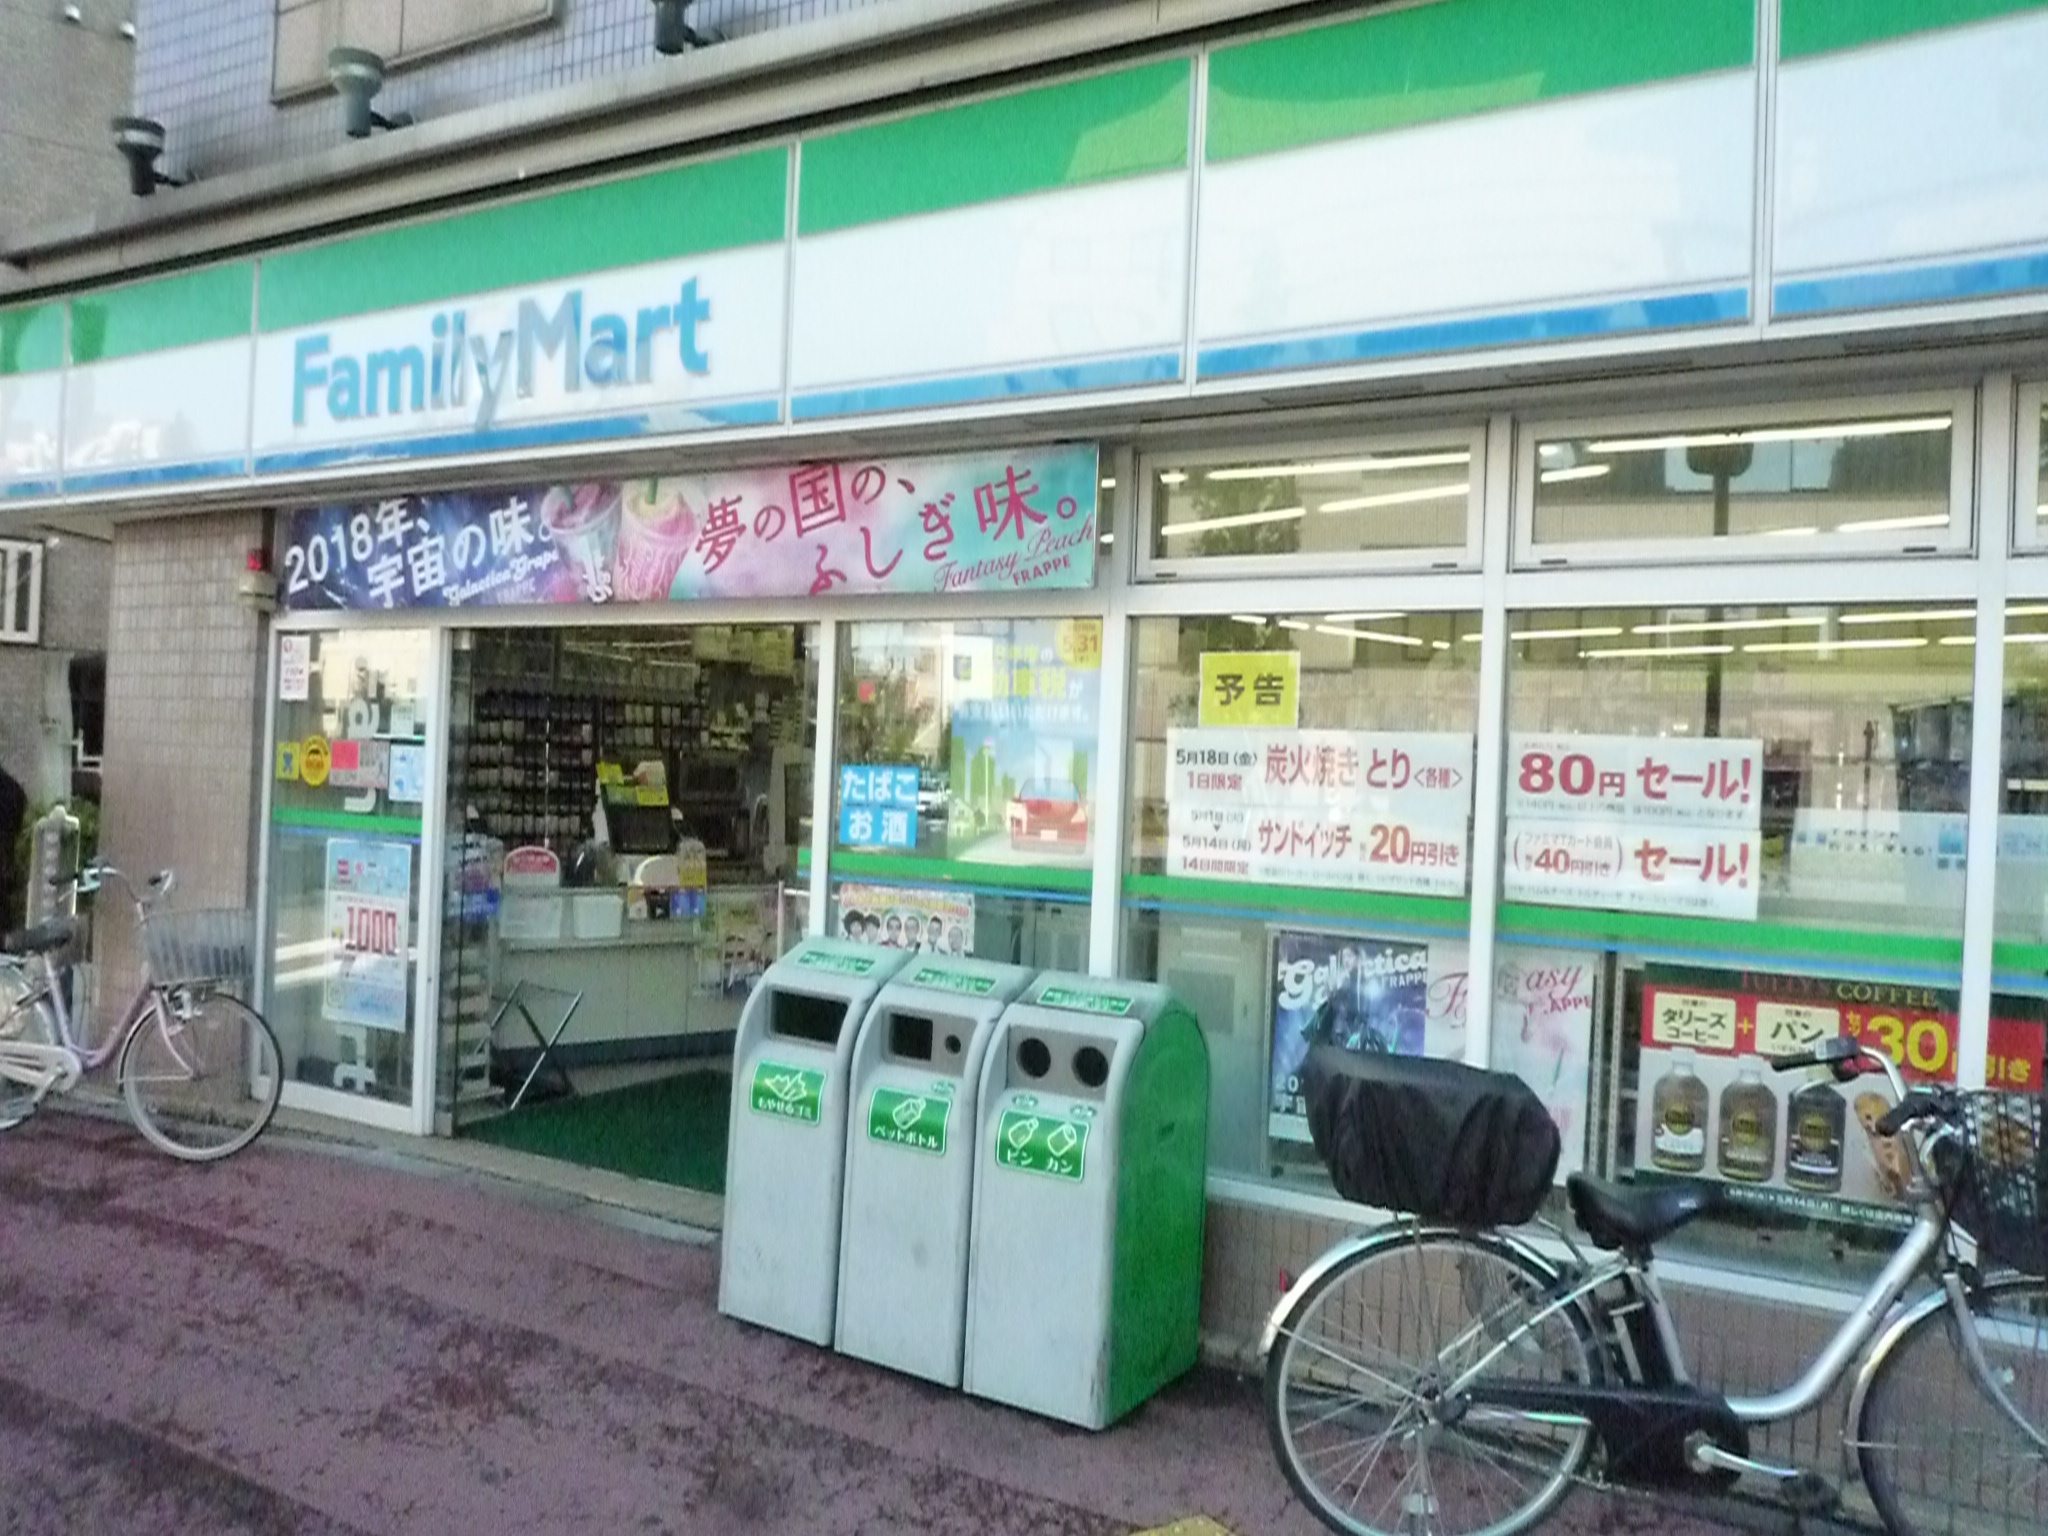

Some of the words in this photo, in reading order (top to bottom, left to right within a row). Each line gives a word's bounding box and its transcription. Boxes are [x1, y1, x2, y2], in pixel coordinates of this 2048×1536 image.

[292, 277, 712, 433] FamilyMart
[934, 551, 1019, 593] Fantasy
[1025, 512, 1093, 561] Peach
[1013, 554, 1071, 586] FRAPPE
[1215, 673, 1284, 706] 予告
[843, 769, 916, 802] たばこ
[1187, 771, 1243, 791] 1日限定
[1519, 752, 1625, 797] 80円
[848, 810, 908, 844] お酒
[1258, 818, 1352, 860] サンドイッチ
[1369, 822, 1460, 867] 20円引き
[1836, 983, 1939, 1008] COFFEE
[1662, 1008, 1728, 1030] タリーズ
[1667, 1026, 1720, 1044] コーヒー
[874, 1124, 938, 1149] ペットボトル
[1046, 1156, 1073, 1173] カン
